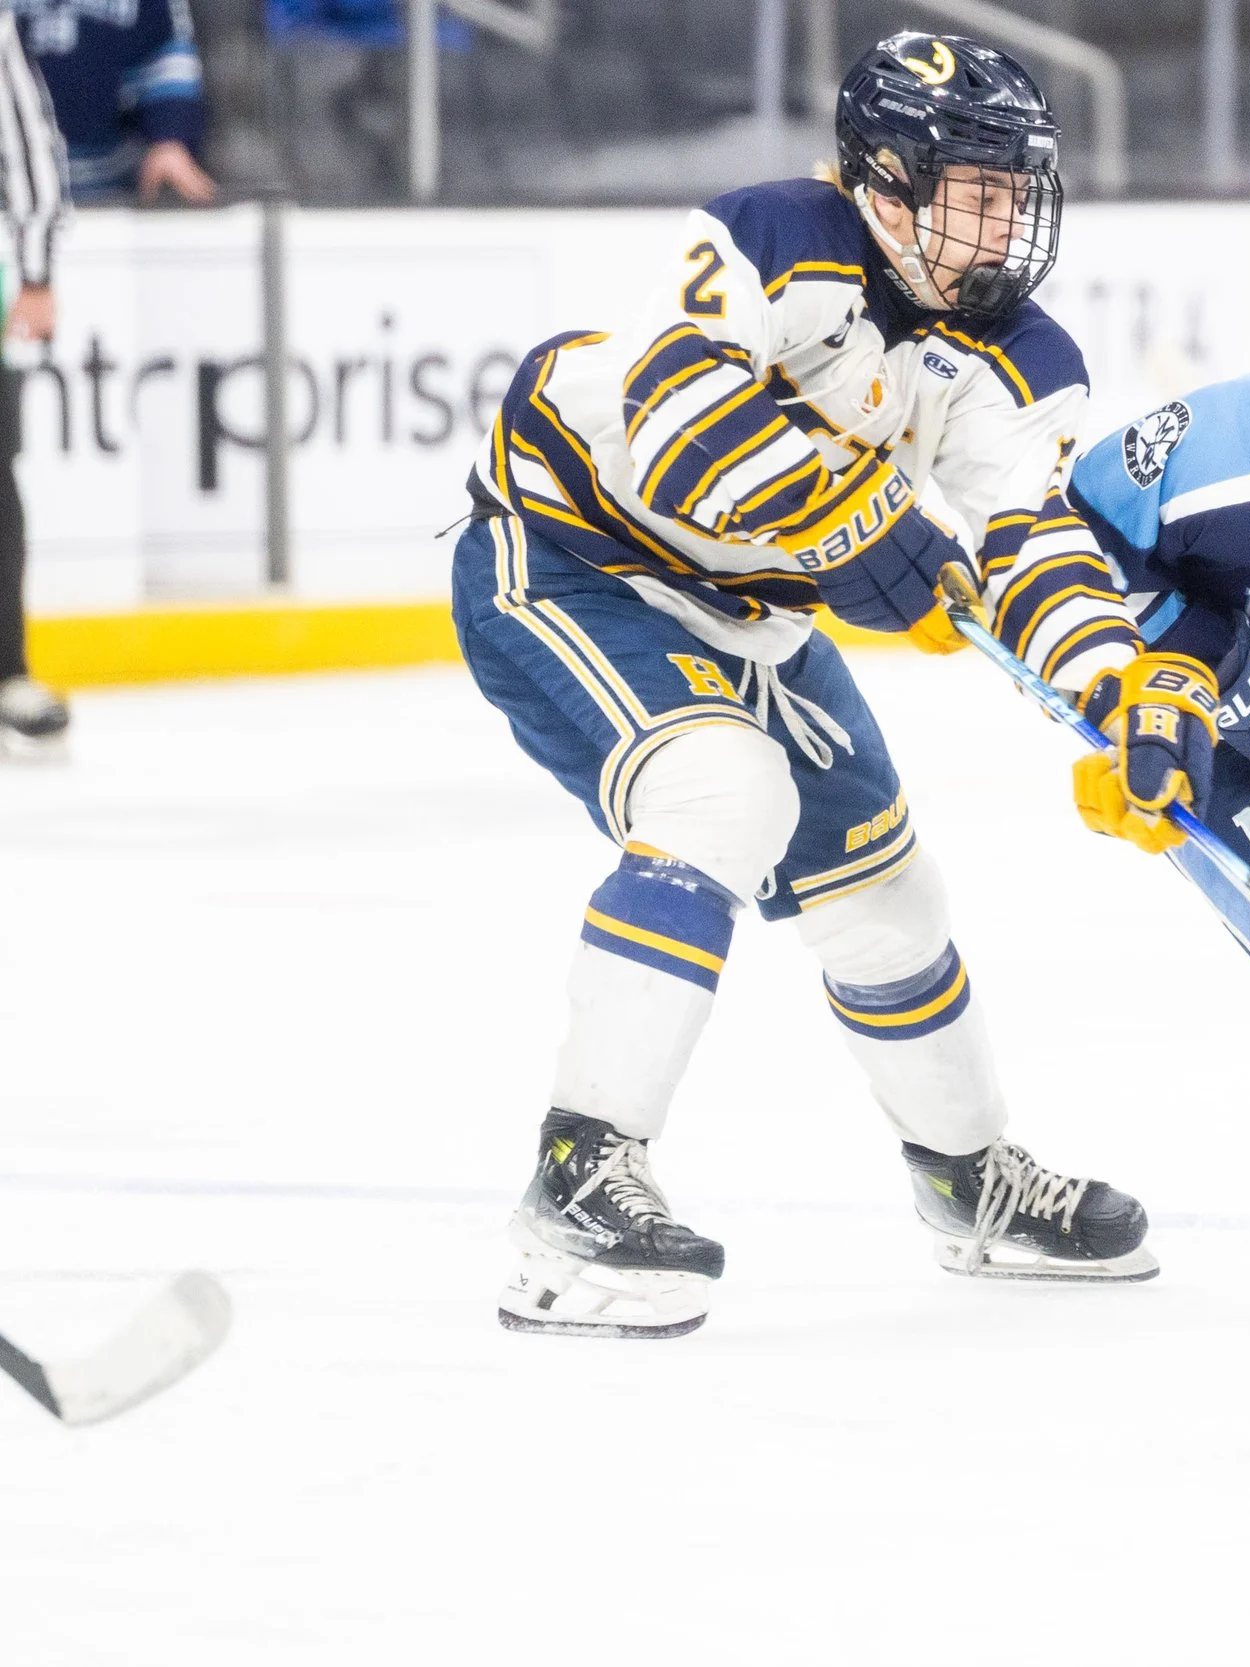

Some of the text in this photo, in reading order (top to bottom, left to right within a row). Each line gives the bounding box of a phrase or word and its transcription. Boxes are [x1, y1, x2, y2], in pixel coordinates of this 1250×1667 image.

[680, 239, 728, 320] 2
[795, 466, 914, 571] BAUE
[665, 652, 746, 706] H
[1136, 706, 1180, 745] H
